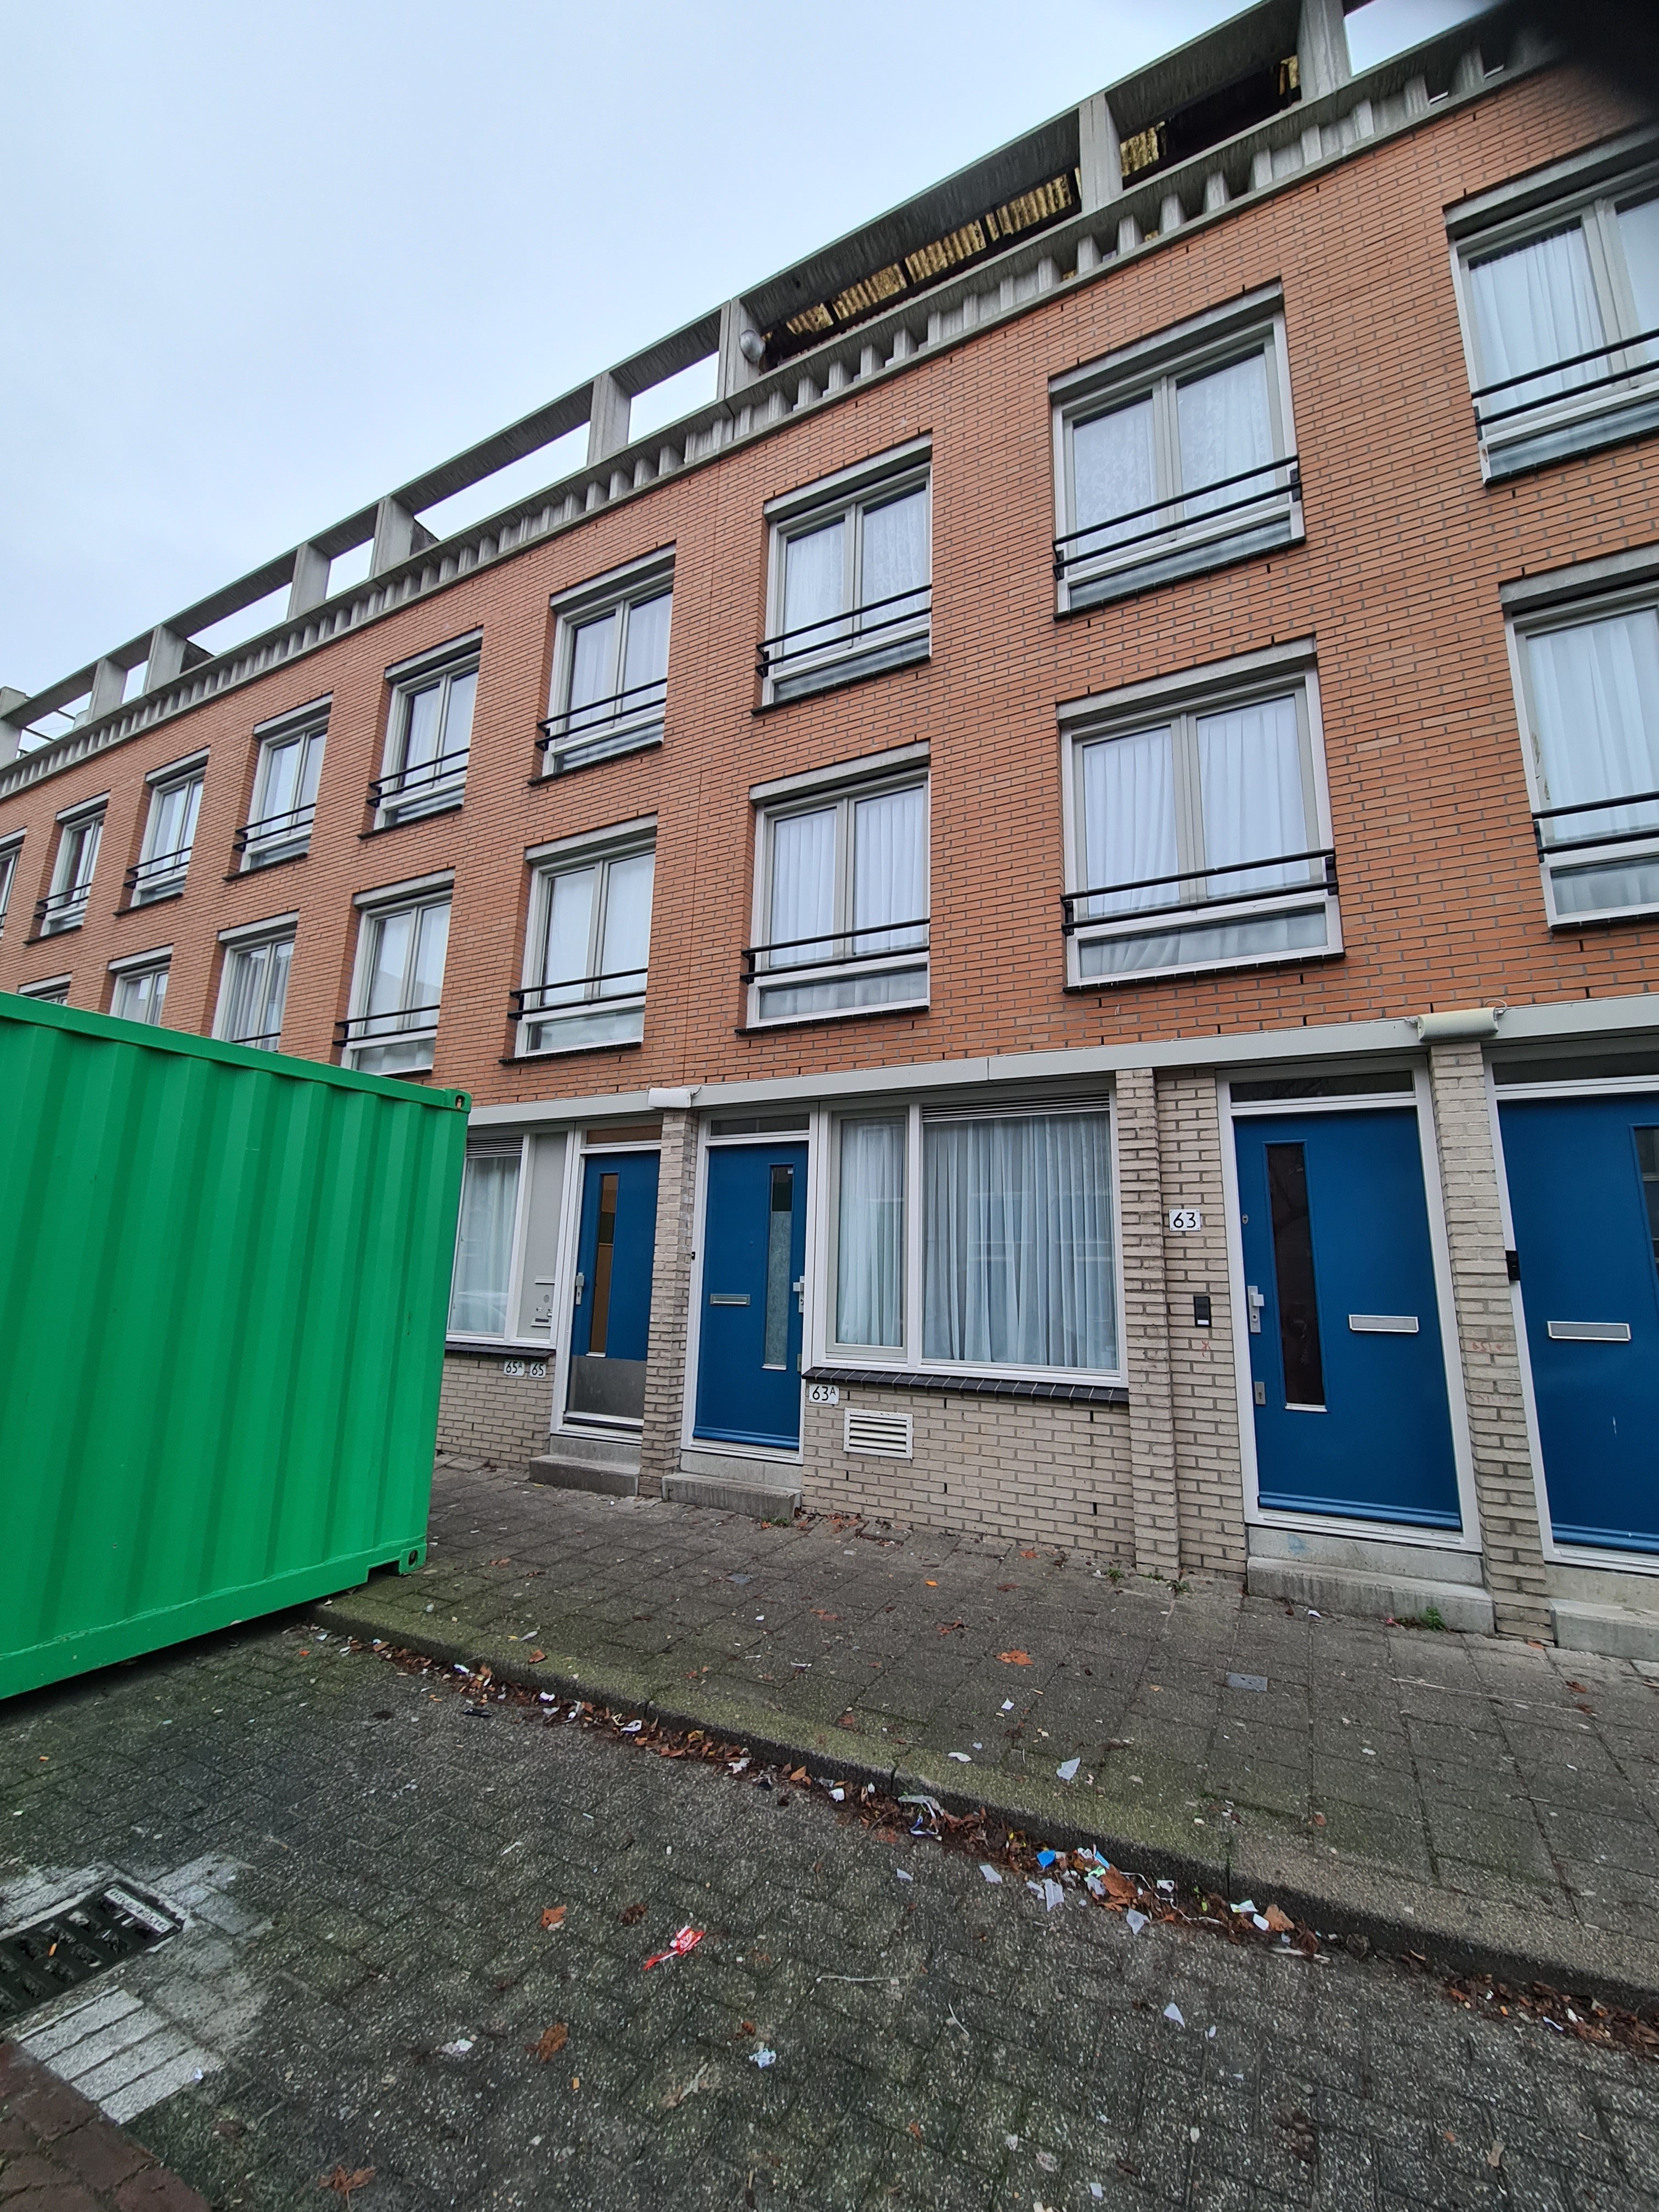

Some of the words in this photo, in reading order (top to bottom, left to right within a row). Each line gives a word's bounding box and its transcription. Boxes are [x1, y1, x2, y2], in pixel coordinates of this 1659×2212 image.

[1173, 1212, 1196, 1228] 63
[532, 1363, 544, 1376] 65
[812, 1386, 836, 1401] 63A
